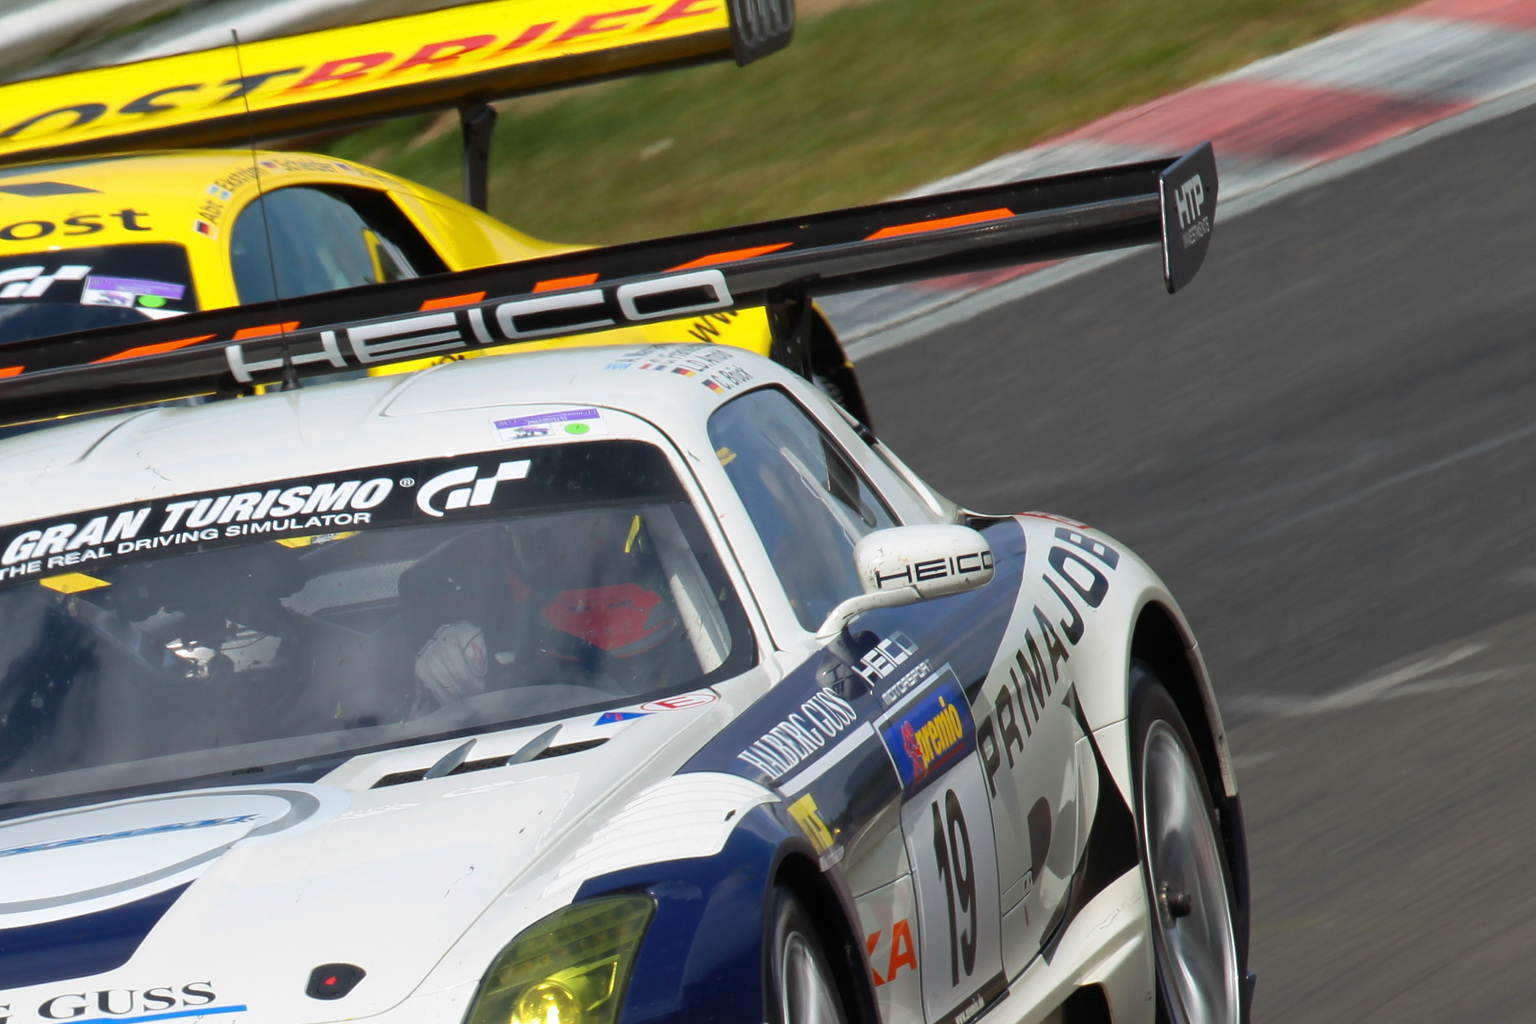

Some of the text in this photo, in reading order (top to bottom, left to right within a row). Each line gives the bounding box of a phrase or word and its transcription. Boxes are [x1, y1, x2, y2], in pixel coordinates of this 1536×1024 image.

[196, 199, 225, 226] Abt
[1174, 173, 1205, 229] HTP
[225, 269, 735, 383] HEICO
[1, 477, 394, 566] GRAN TURISMO
[47, 548, 112, 570] REAL
[116, 528, 219, 555] DRIVING
[224, 512, 372, 538] SIMULATOR
[875, 550, 994, 589] HEICO
[851, 630, 920, 688] HEICO
[880, 658, 934, 707] MOTORSPORT
[975, 526, 1121, 799] PRIMAJOB
[736, 686, 858, 781] HALBERG GUSS
[914, 695, 964, 772] premio
[930, 787, 977, 988] 19
[37, 979, 218, 1021] GUSS
